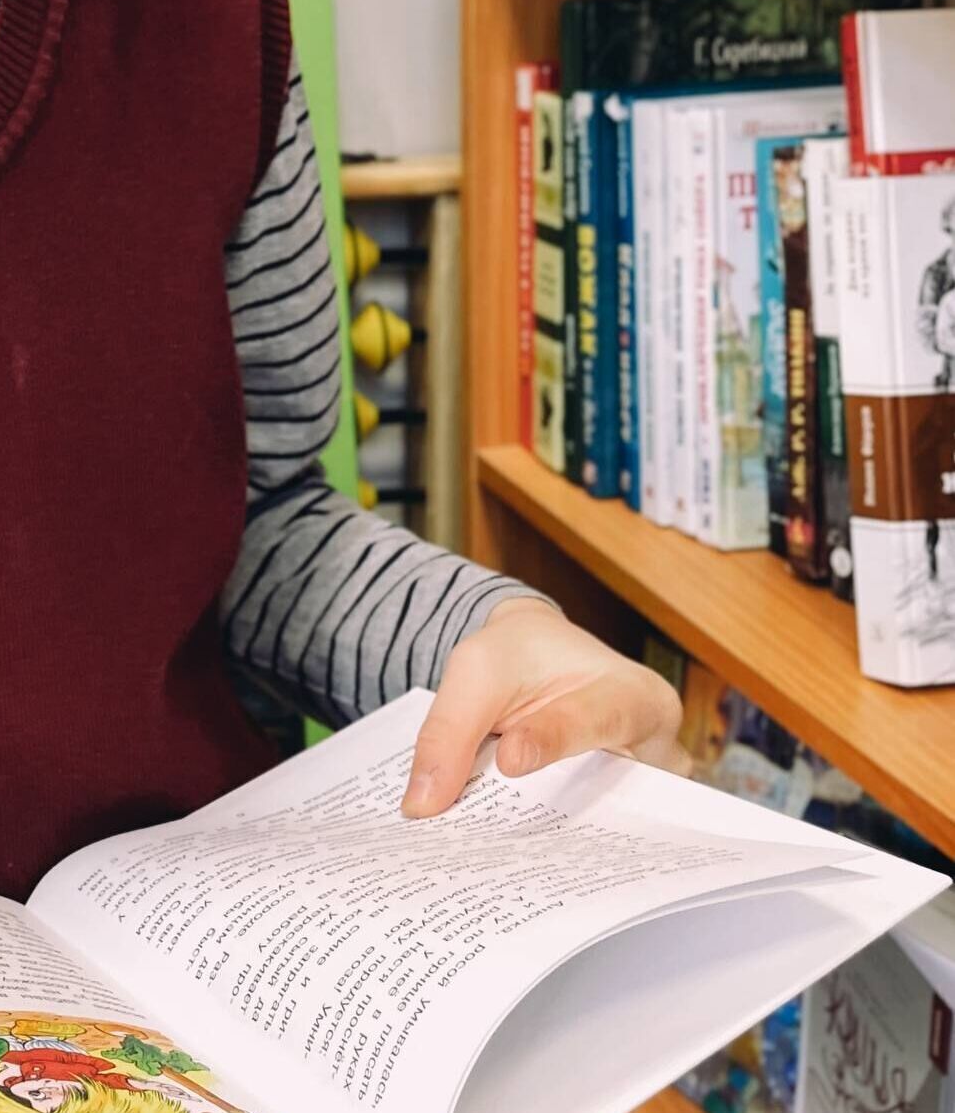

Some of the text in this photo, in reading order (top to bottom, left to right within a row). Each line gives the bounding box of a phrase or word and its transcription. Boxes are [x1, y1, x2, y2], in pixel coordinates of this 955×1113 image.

[133, 879, 187, 936] пирогом
[142, 898, 181, 943] Сядет
[214, 876, 294, 947] гусеницам
[222, 882, 266, 920] чтобы
[326, 905, 361, 938] коня
[432, 890, 502, 936] бабушка
[442, 902, 498, 944] работа
[182, 925, 217, 973] быст-
[255, 901, 307, 955] работу
[314, 921, 360, 968] спине
[382, 915, 412, 942] Вот
[391, 905, 447, 948] внучку,
[462, 927, 483, 946] по
[192, 956, 211, 981] да
[203, 950, 230, 989] Раз-
[237, 900, 330, 1014] перескакивает
[265, 934, 309, 988] сытый
[332, 942, 375, 994] егоза!
[377, 938, 423, 985] Настя
[394, 948, 455, 1013] горнице
[436, 941, 485, 990] росой
[224, 962, 254, 1006] про-
[259, 942, 320, 1032] запрягать
[316, 951, 387, 1057] порадуется:
[385, 965, 415, 999] неё
[248, 997, 267, 1023] да
[273, 998, 298, 1040] гри-
[299, 1003, 331, 1060] Умни-
[327, 992, 373, 1080] проснёт-
[368, 996, 430, 1110] умывалась,
[340, 1032, 369, 1090] руках
[354, 1023, 393, 1101] плясать
